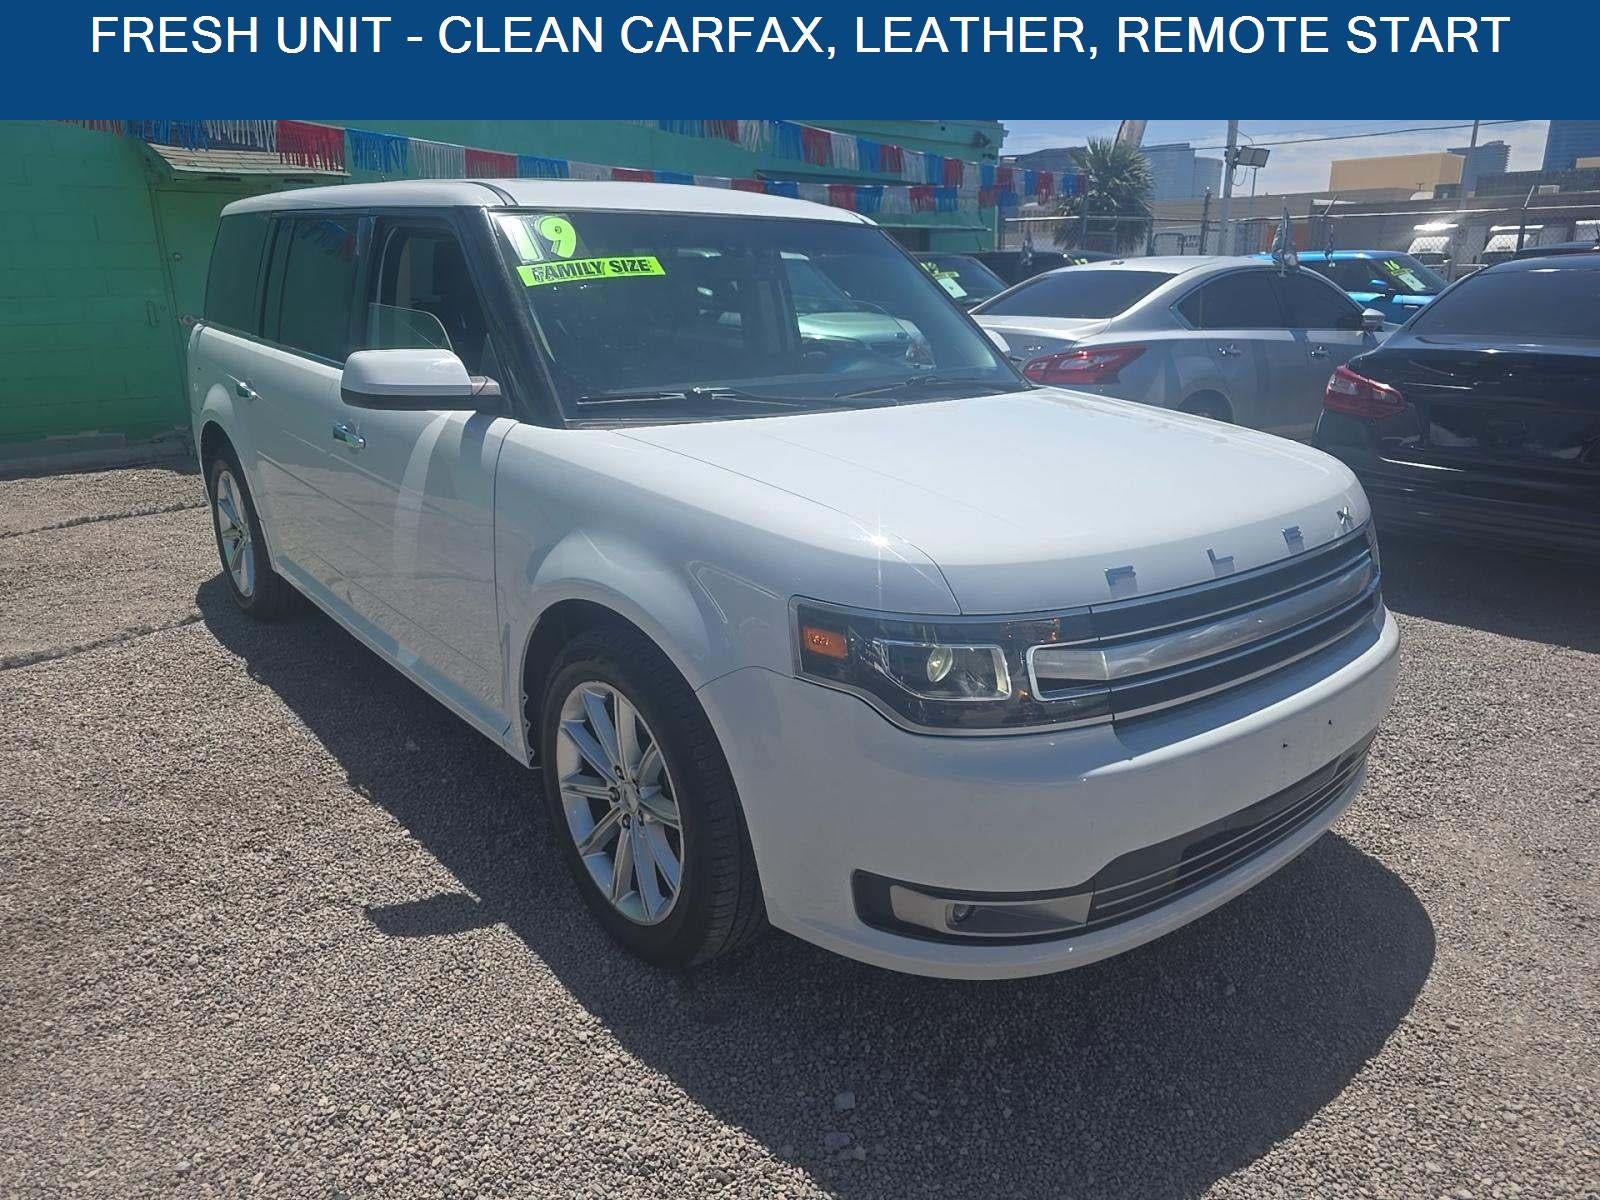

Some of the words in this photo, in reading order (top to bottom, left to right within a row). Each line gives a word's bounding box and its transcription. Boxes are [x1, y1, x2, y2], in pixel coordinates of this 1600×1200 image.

[498, 213, 577, 263] 19
[531, 261, 606, 283] FAMILY
[608, 258, 653, 274] SIZE
